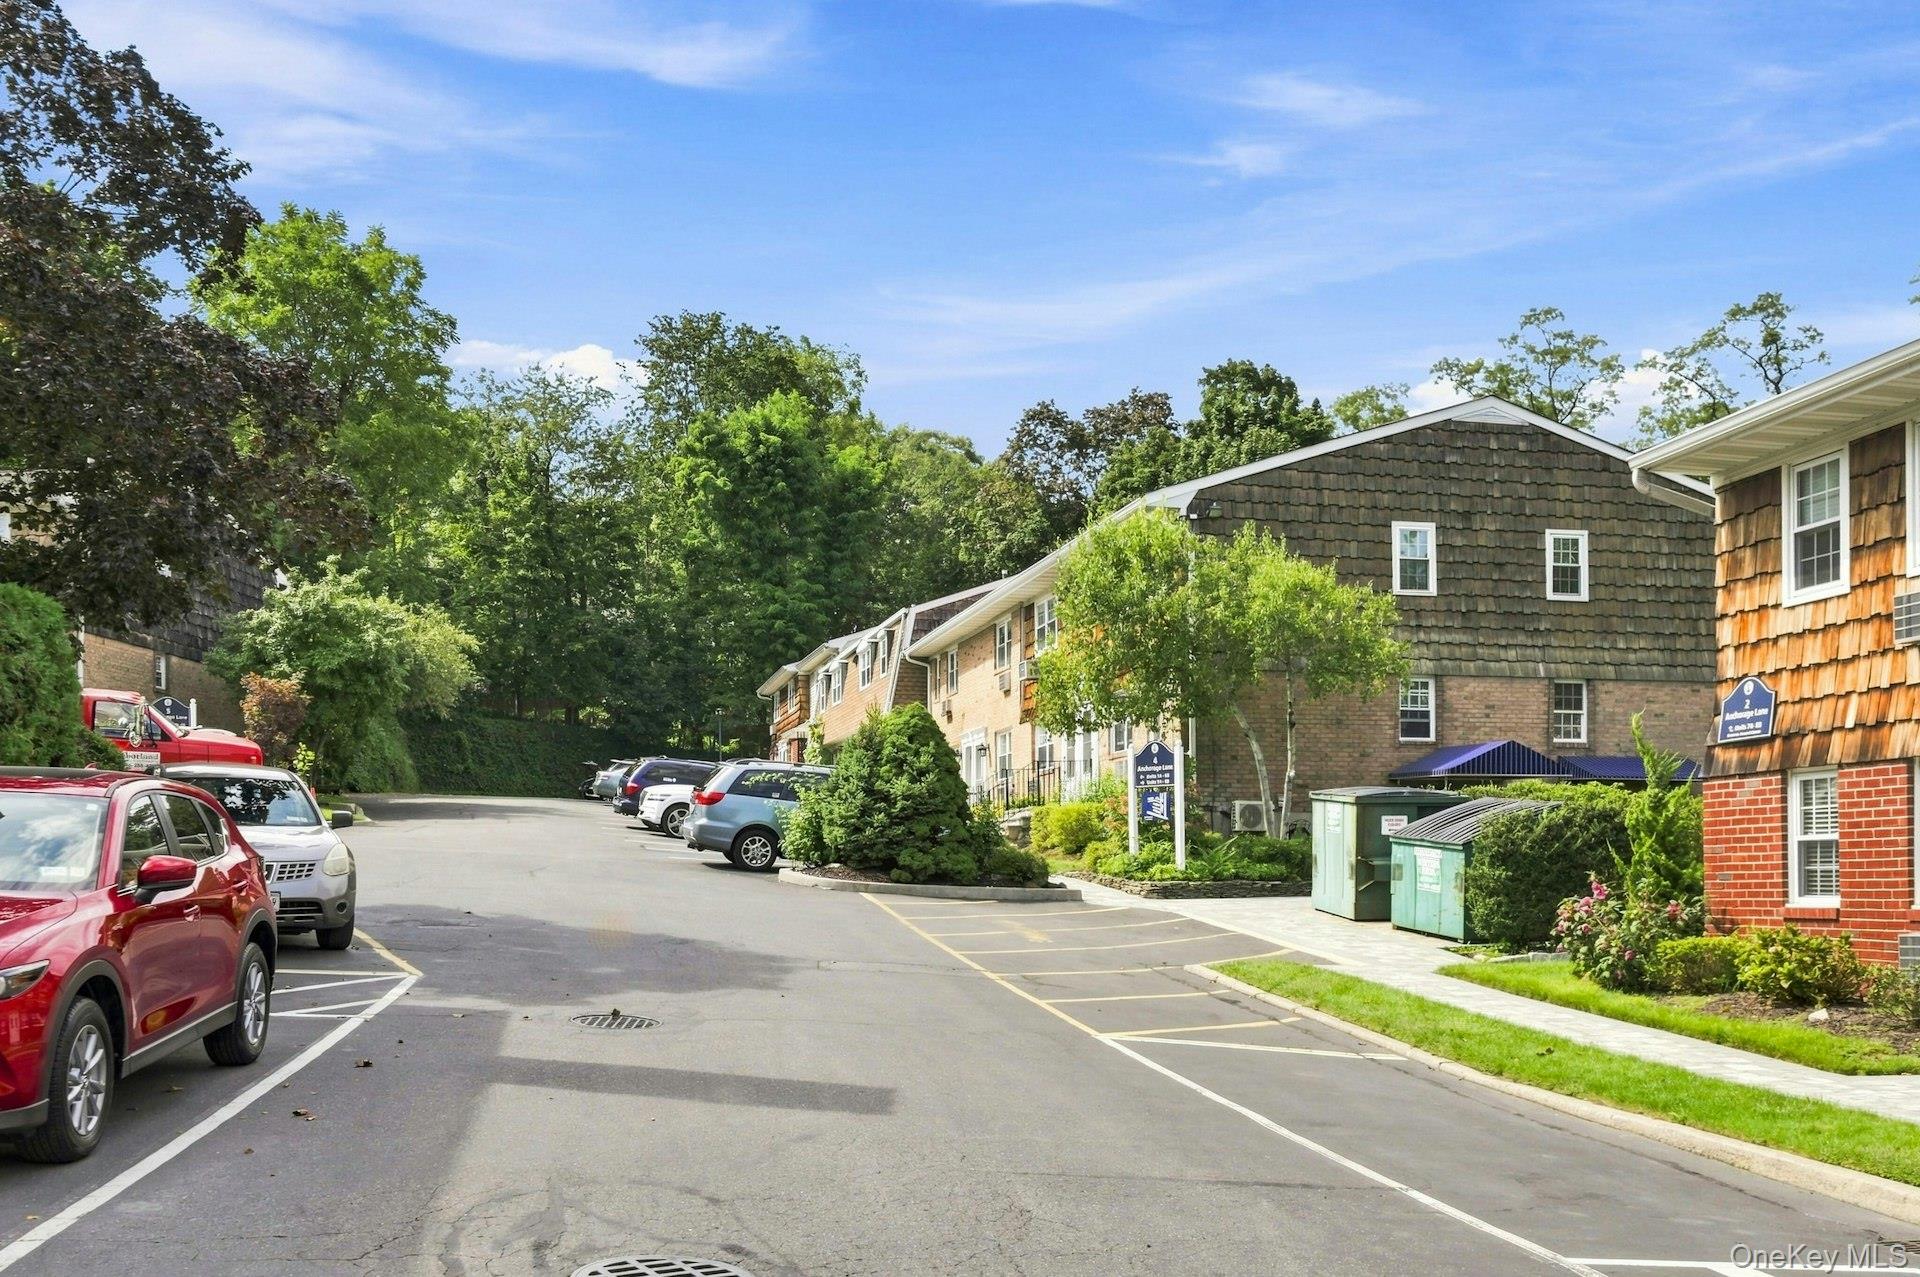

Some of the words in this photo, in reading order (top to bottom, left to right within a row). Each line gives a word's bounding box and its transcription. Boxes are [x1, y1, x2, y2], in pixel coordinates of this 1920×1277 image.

[1744, 699, 1750, 709] 2
[1725, 710, 1754, 720] Anchorage
[1754, 708, 1769, 716] Lane
[1153, 756, 1158, 764] 4
[1137, 765, 1162, 773] Anchorage
